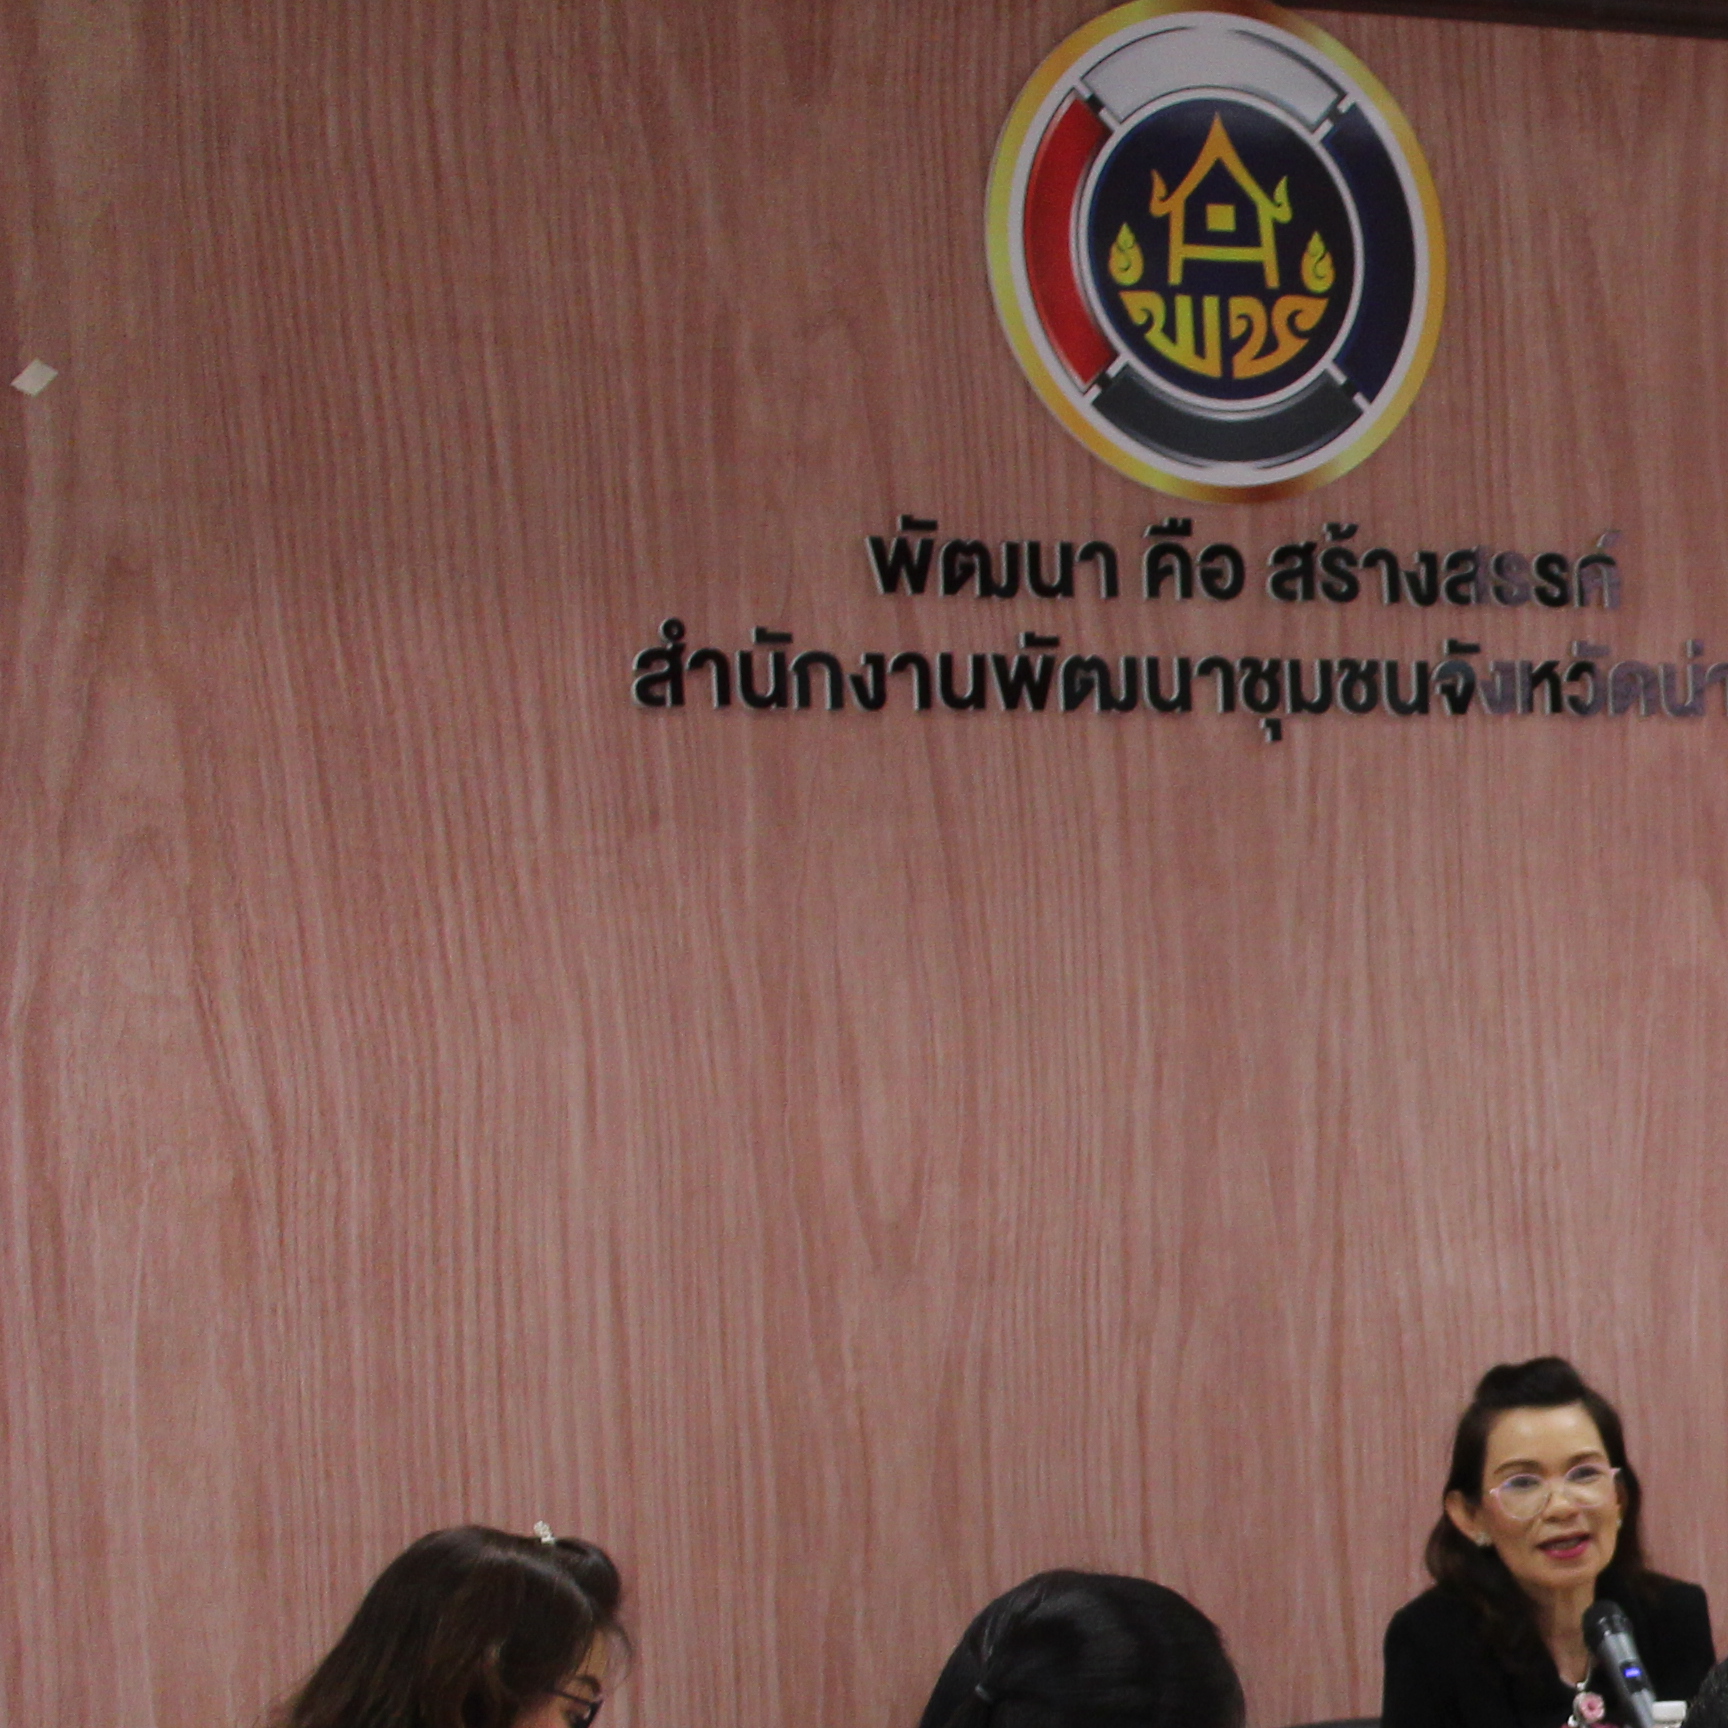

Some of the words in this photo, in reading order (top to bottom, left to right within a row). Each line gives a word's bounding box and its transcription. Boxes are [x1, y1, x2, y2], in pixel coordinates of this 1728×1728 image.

[867, 514, 1119, 599] พัฒนา
[1144, 517, 1245, 600] คือ
[1267, 522, 1621, 608] สร้างสรรค์
